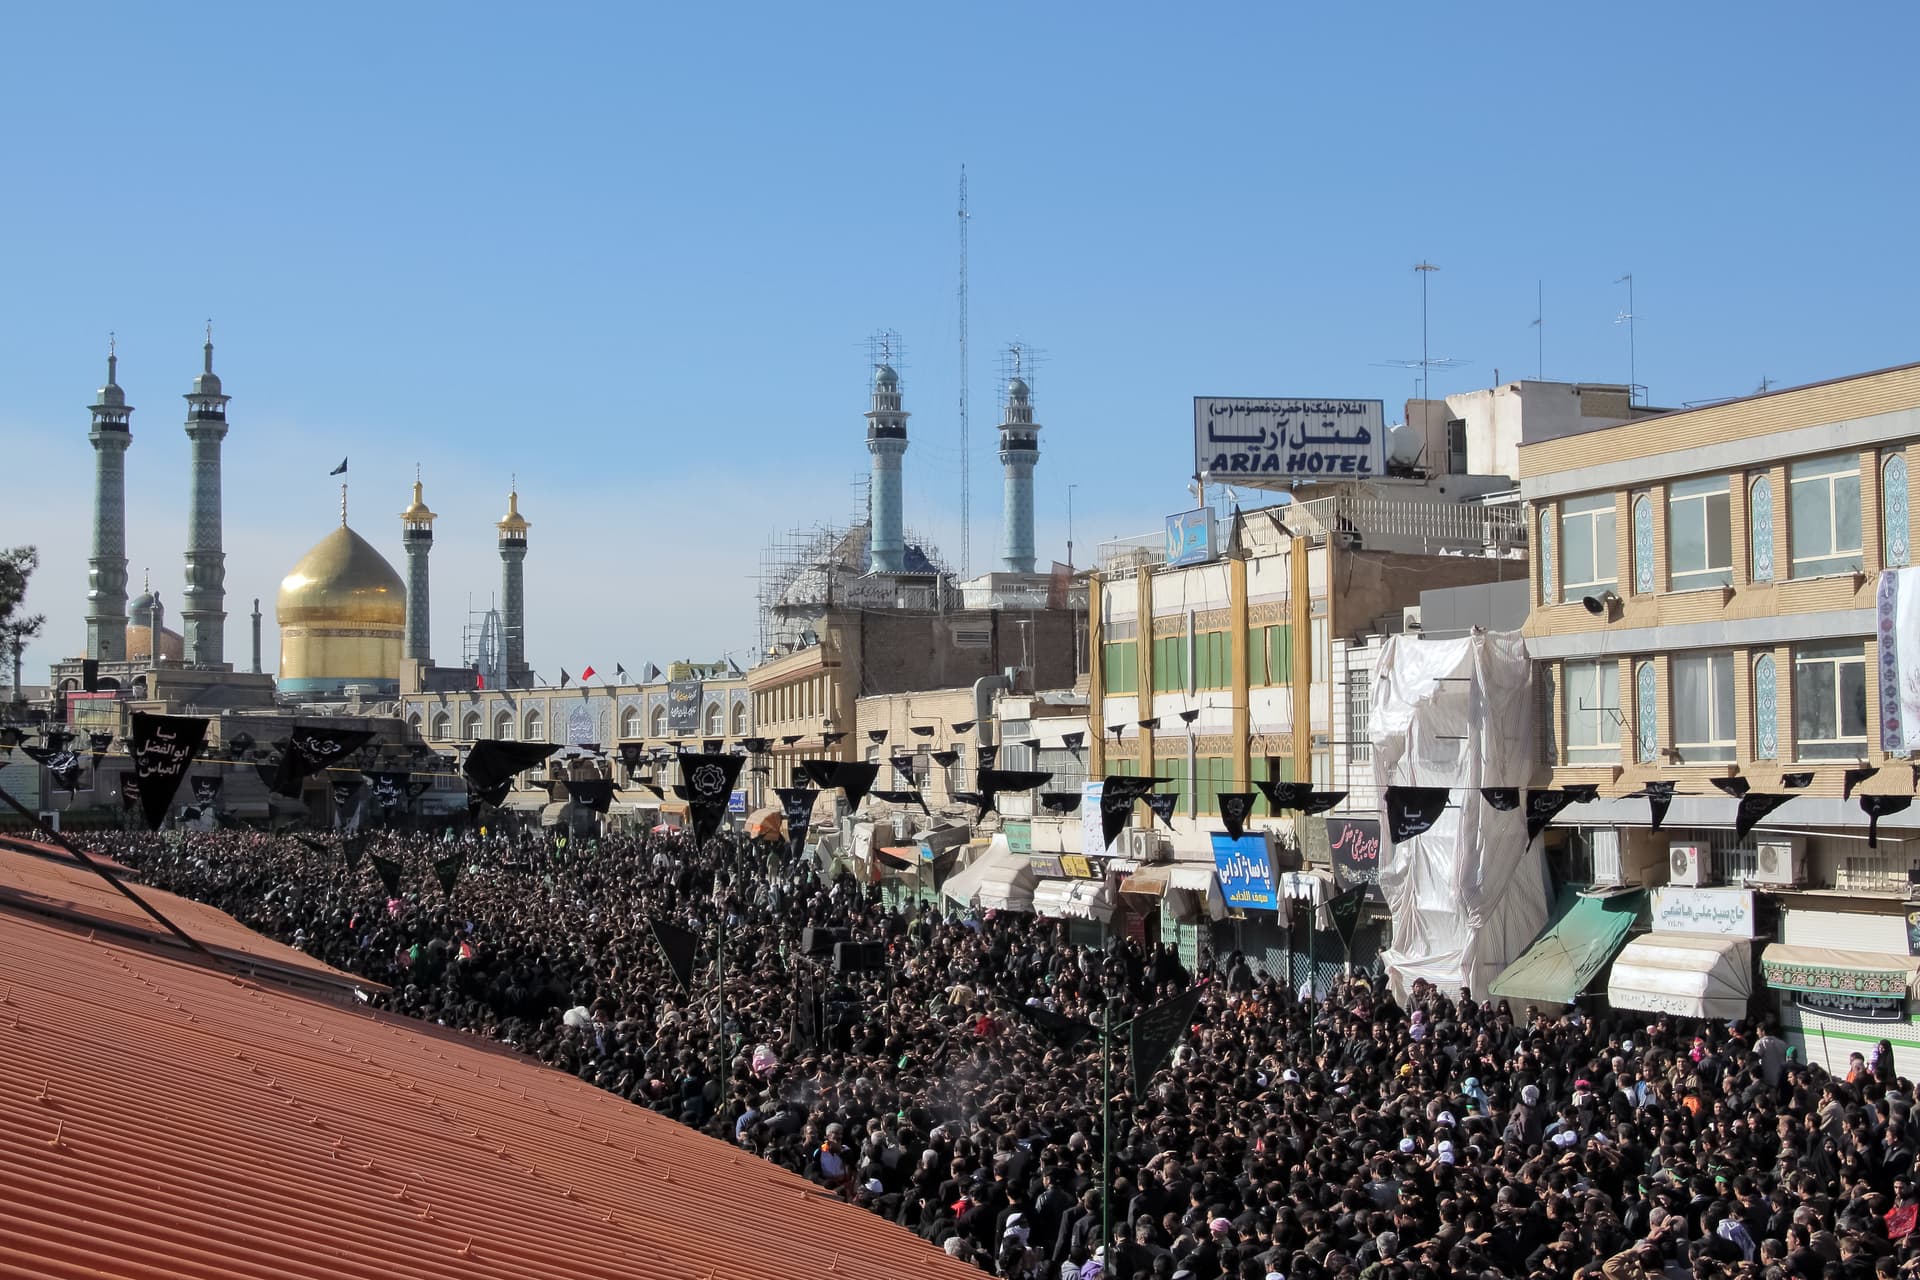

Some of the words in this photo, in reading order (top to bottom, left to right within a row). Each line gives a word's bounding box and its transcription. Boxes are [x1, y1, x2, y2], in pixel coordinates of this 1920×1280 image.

[1207, 418, 1289, 451] آریا
[1289, 421, 1372, 450] هتل
[1209, 453, 1280, 472] ARIA
[1285, 451, 1372, 473] HOTEL
[156, 726, 177, 741] یا
[136, 739, 190, 762] ابوالفضل
[139, 761, 181, 778] العباس
[1403, 805, 1422, 822] یا
[1397, 821, 1430, 836] حسین
[1242, 856, 1271, 890] پاساژ
[1661, 898, 1692, 920] هاشمی
[1692, 904, 1712, 922] علی
[1712, 906, 1730, 925] سید
[1730, 904, 1745, 924] حاج
